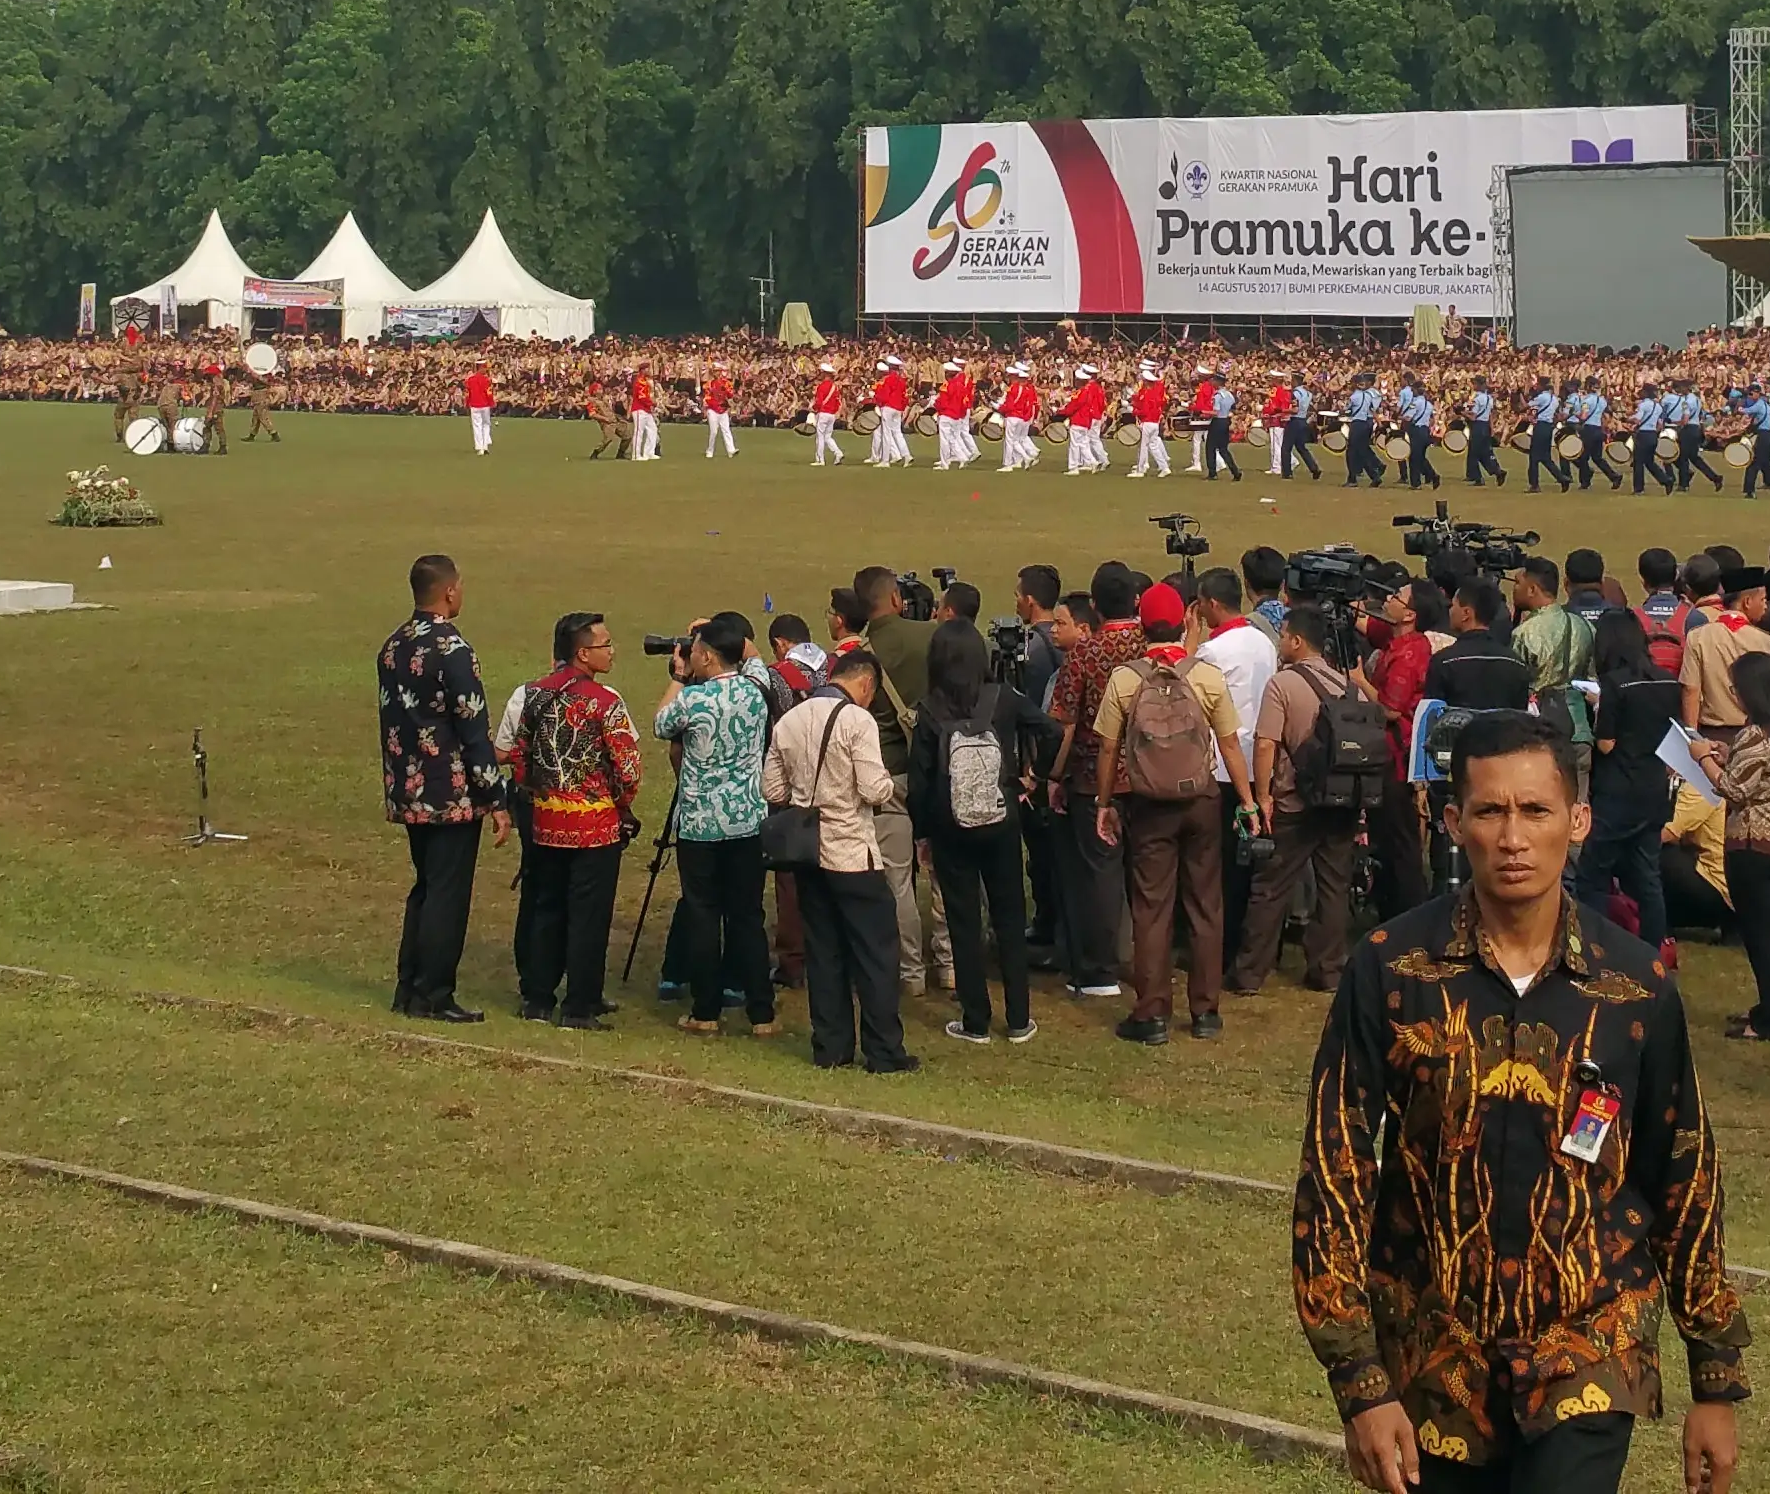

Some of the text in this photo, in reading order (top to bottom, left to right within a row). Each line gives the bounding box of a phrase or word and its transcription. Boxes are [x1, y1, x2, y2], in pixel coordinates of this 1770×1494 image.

[1220, 169, 1318, 181] KWARTIR NASIONAL
[1327, 150, 1442, 203] Hari
[1218, 181, 1319, 193] GERAKAN PRAMUKA
[1157, 208, 1486, 256] Pramuka ke-
[963, 236, 1050, 252] GERAKAN
[959, 253, 1045, 267] PRAMUKA
[1158, 263, 1200, 278] Bekerja
[1202, 264, 1236, 275] untuk
[1238, 264, 1271, 276] Kaum
[1274, 264, 1310, 277] Muda,
[1312, 264, 1386, 276] Mewariskan
[1388, 266, 1417, 279] yang
[1420, 264, 1464, 276] Terbaik
[1467, 263, 1493, 279] bagi
[1198, 283, 1493, 296] 14 AGUSTUS 2017 BUMI PERKEMAHAN CIBUBUR, JAKARTA
